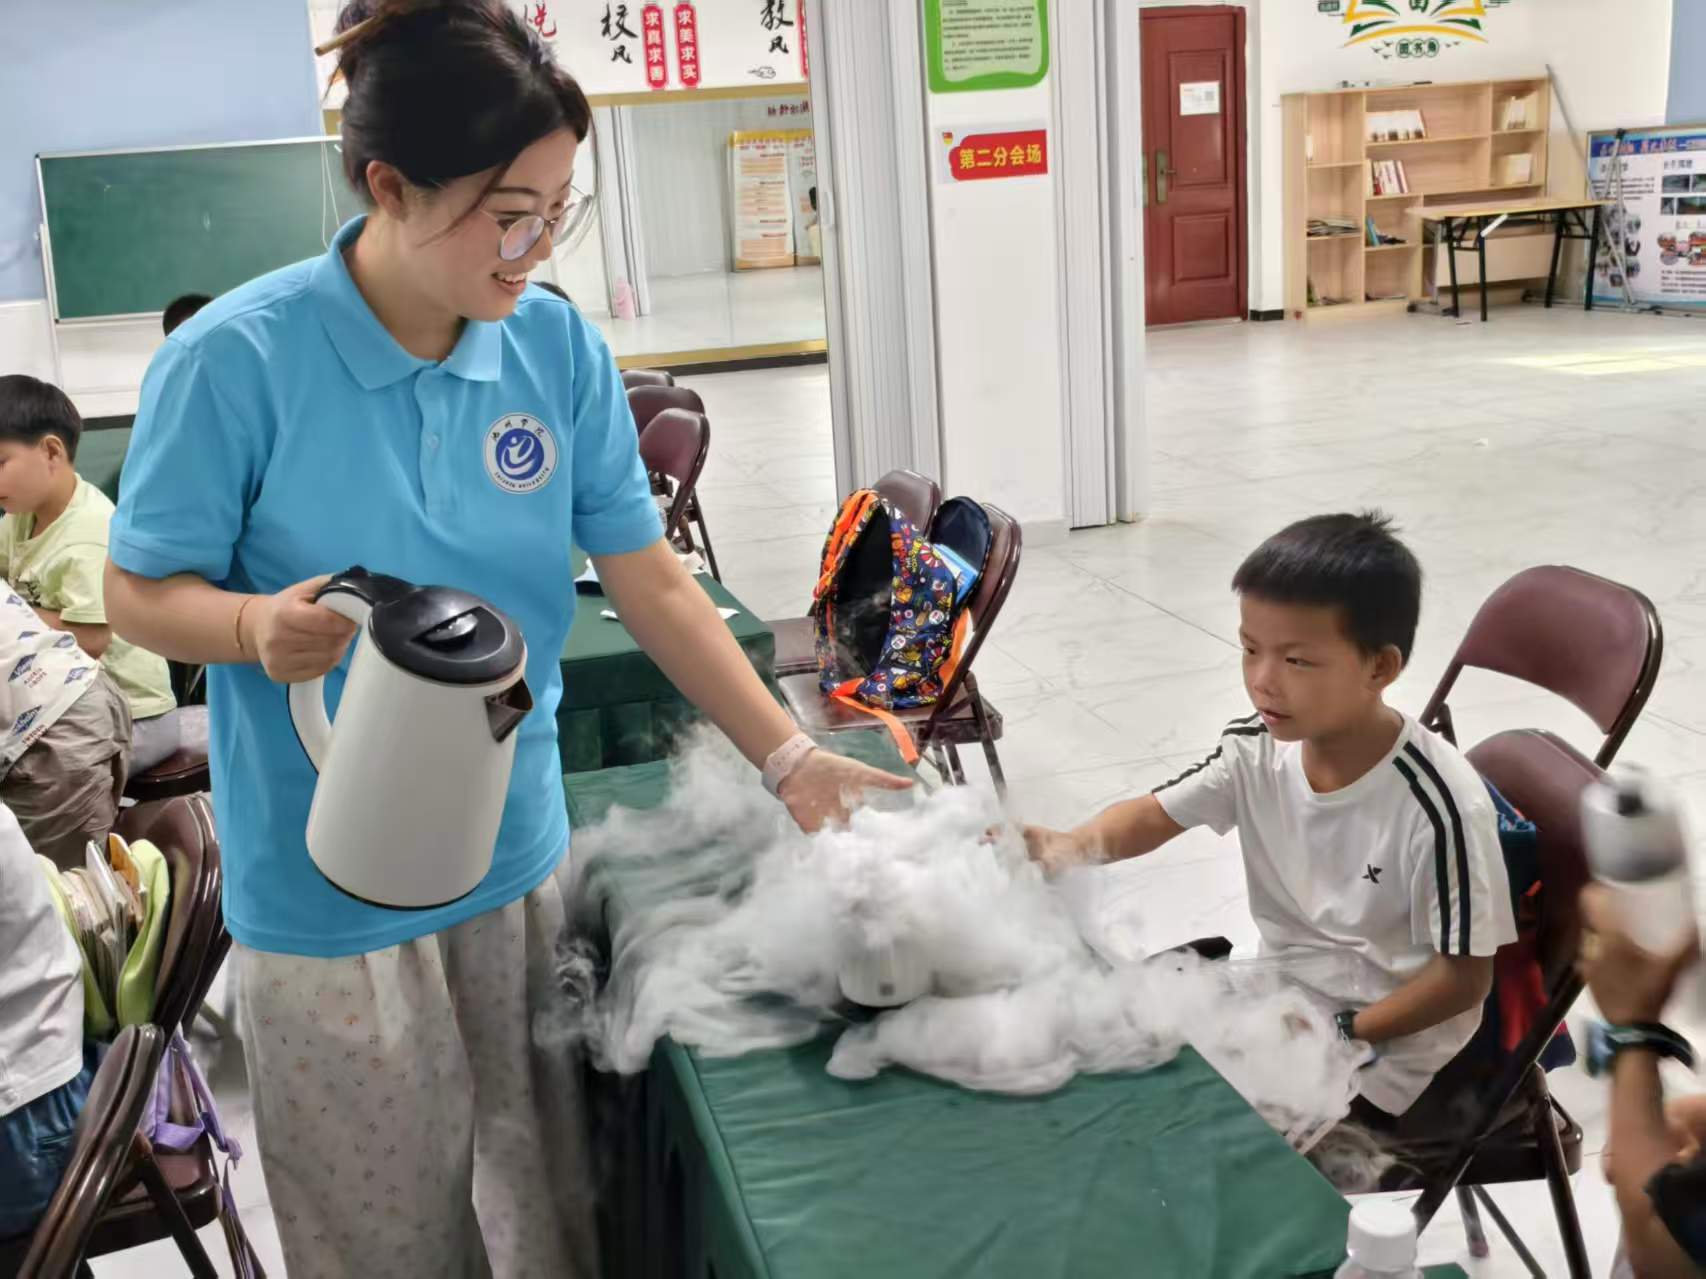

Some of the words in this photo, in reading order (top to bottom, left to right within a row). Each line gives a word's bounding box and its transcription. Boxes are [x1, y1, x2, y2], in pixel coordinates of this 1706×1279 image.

[600, 3, 639, 64] 校风
[760, 0, 794, 54] 教风
[959, 143, 1042, 169] 第二分会场
